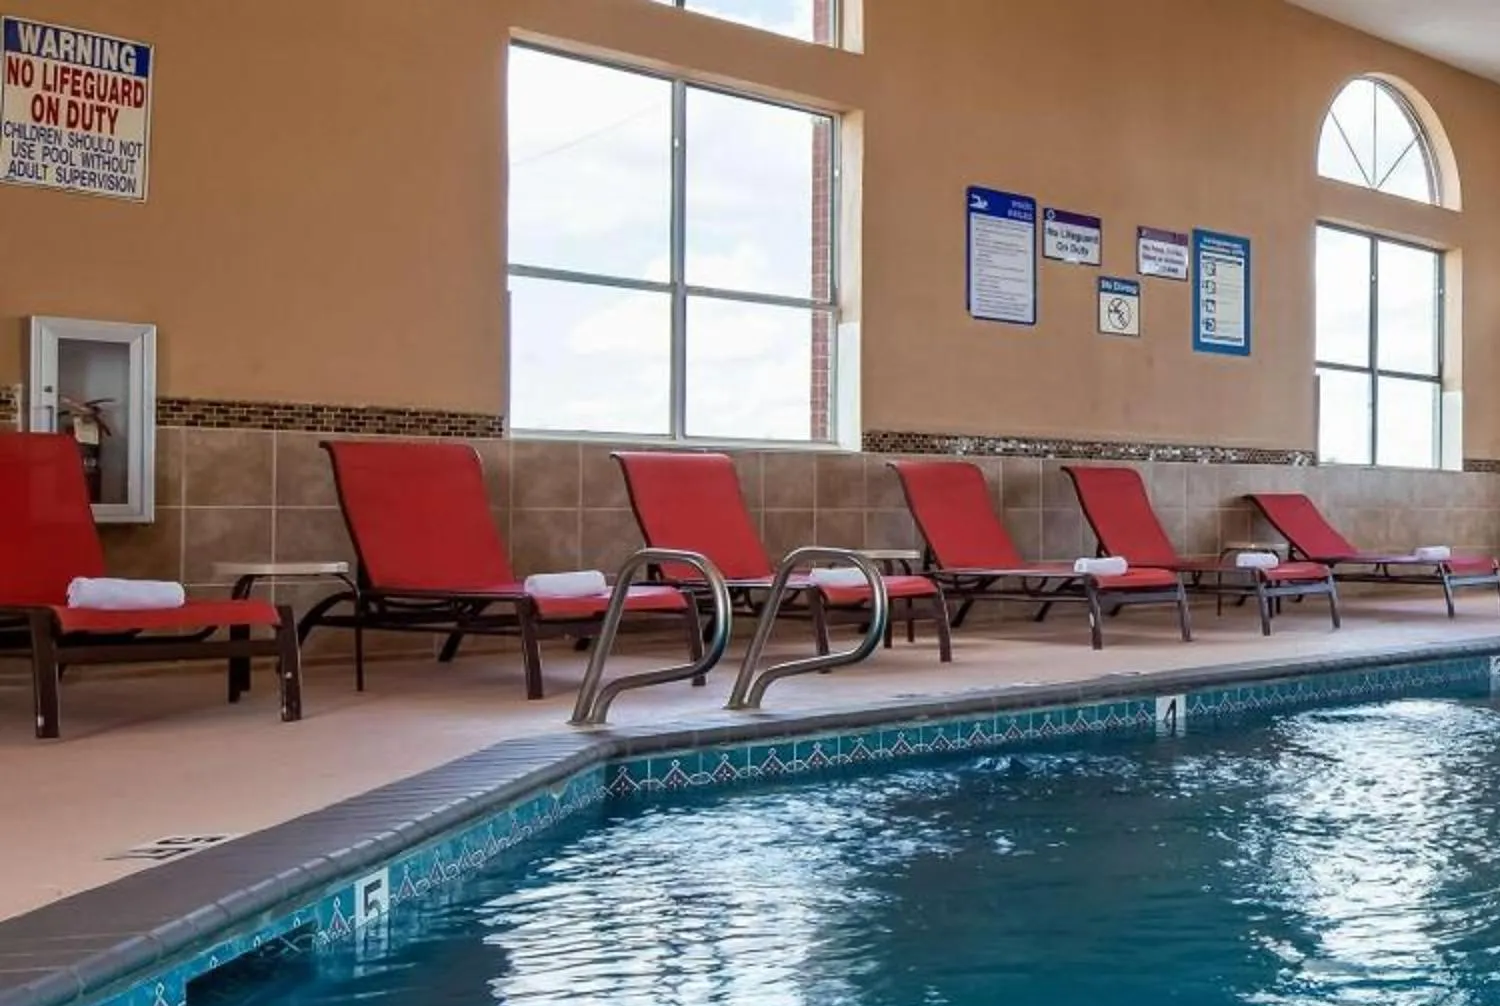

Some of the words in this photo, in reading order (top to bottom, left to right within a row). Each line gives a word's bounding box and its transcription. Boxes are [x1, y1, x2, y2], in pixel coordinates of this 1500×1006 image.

[17, 22, 137, 74] WARNING
[7, 56, 34, 88] NO
[42, 62, 145, 109] LIFEGUARD
[31, 94, 60, 126] ON
[67, 100, 119, 135] DUTY
[3, 120, 63, 145] CHILDREN
[67, 131, 115, 153] SHOULD
[119, 142, 143, 160] NOT
[11, 141, 35, 161] USE
[41, 146, 76, 167] POOL
[81, 152, 137, 175] WITHOUT
[8, 160, 48, 181] ADULT
[55, 168, 137, 194] SUPERVISION
